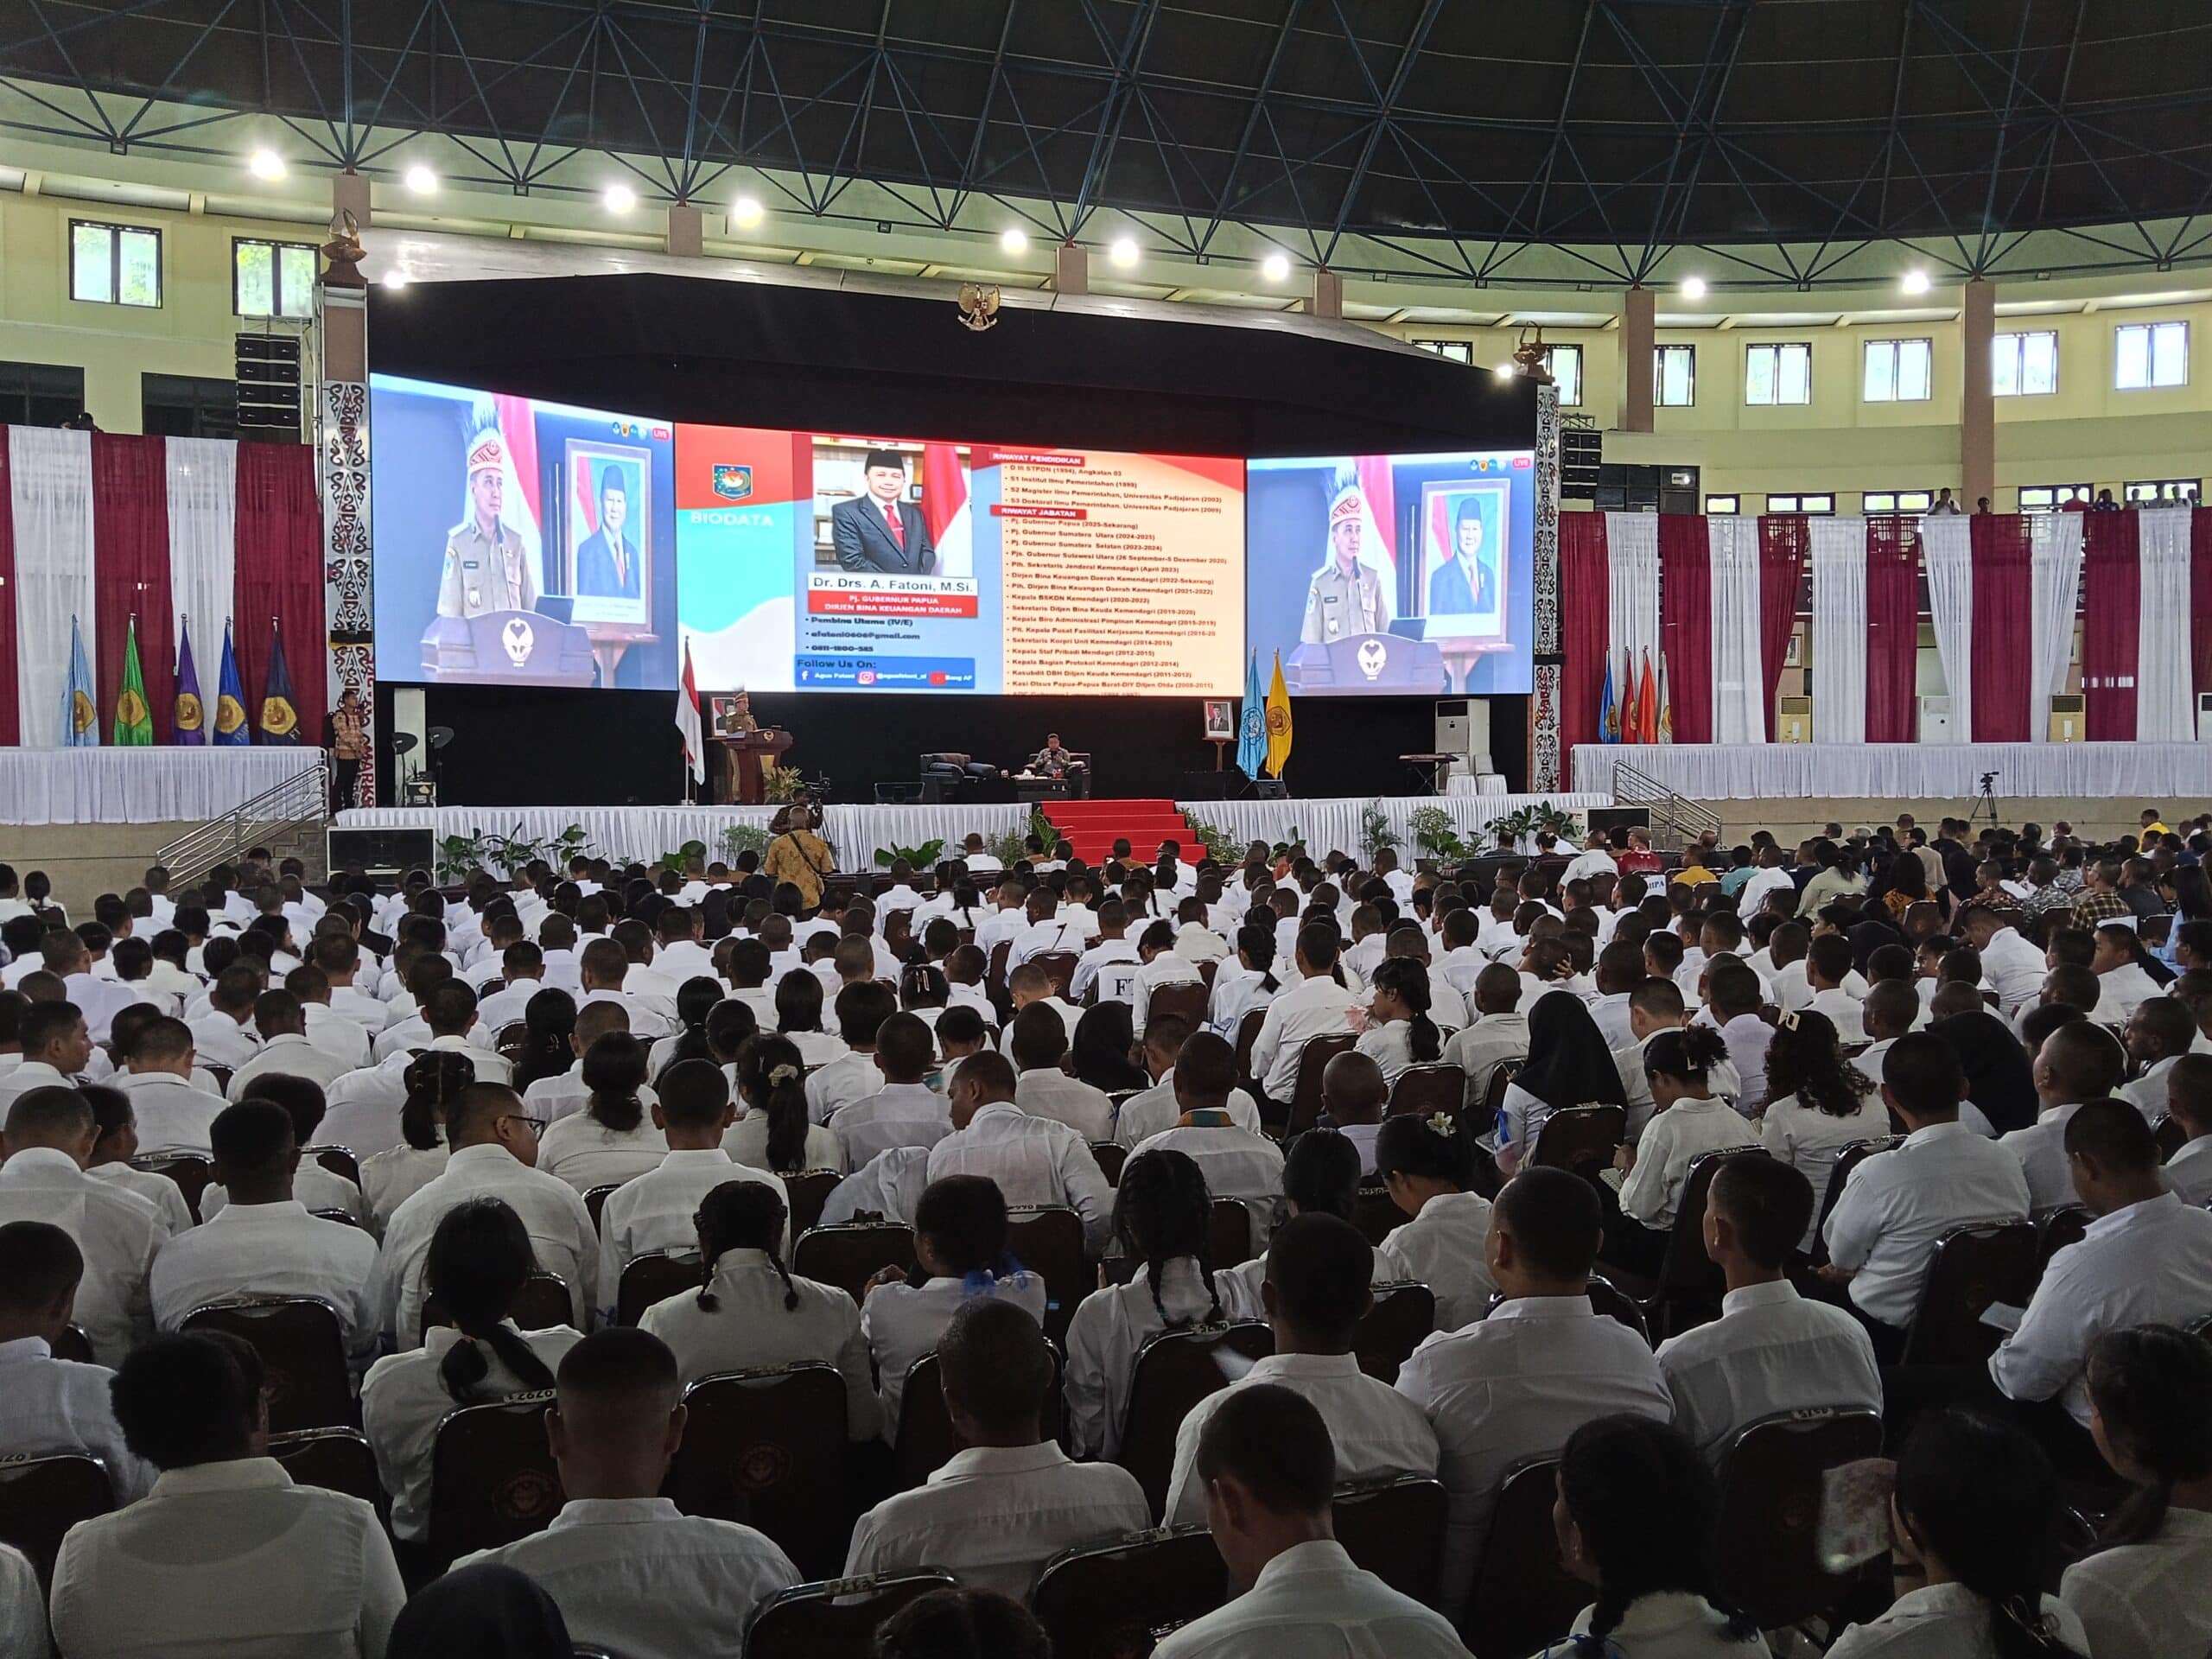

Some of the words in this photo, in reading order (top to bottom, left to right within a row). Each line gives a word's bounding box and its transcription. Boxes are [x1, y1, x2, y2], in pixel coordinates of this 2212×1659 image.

[993, 453, 1029, 461] RIWAYAT
[1031, 455, 1081, 464] PENDIDIKAN
[690, 511, 774, 526] BIODATA
[814, 577, 833, 588] Dr.
[838, 578, 866, 588] Drs.
[871, 580, 884, 588] A.
[889, 581, 935, 591] Fatoni,
[940, 582, 973, 592] M.Si.
[797, 659, 835, 668] Follow
[856, 660, 876, 669] On:
